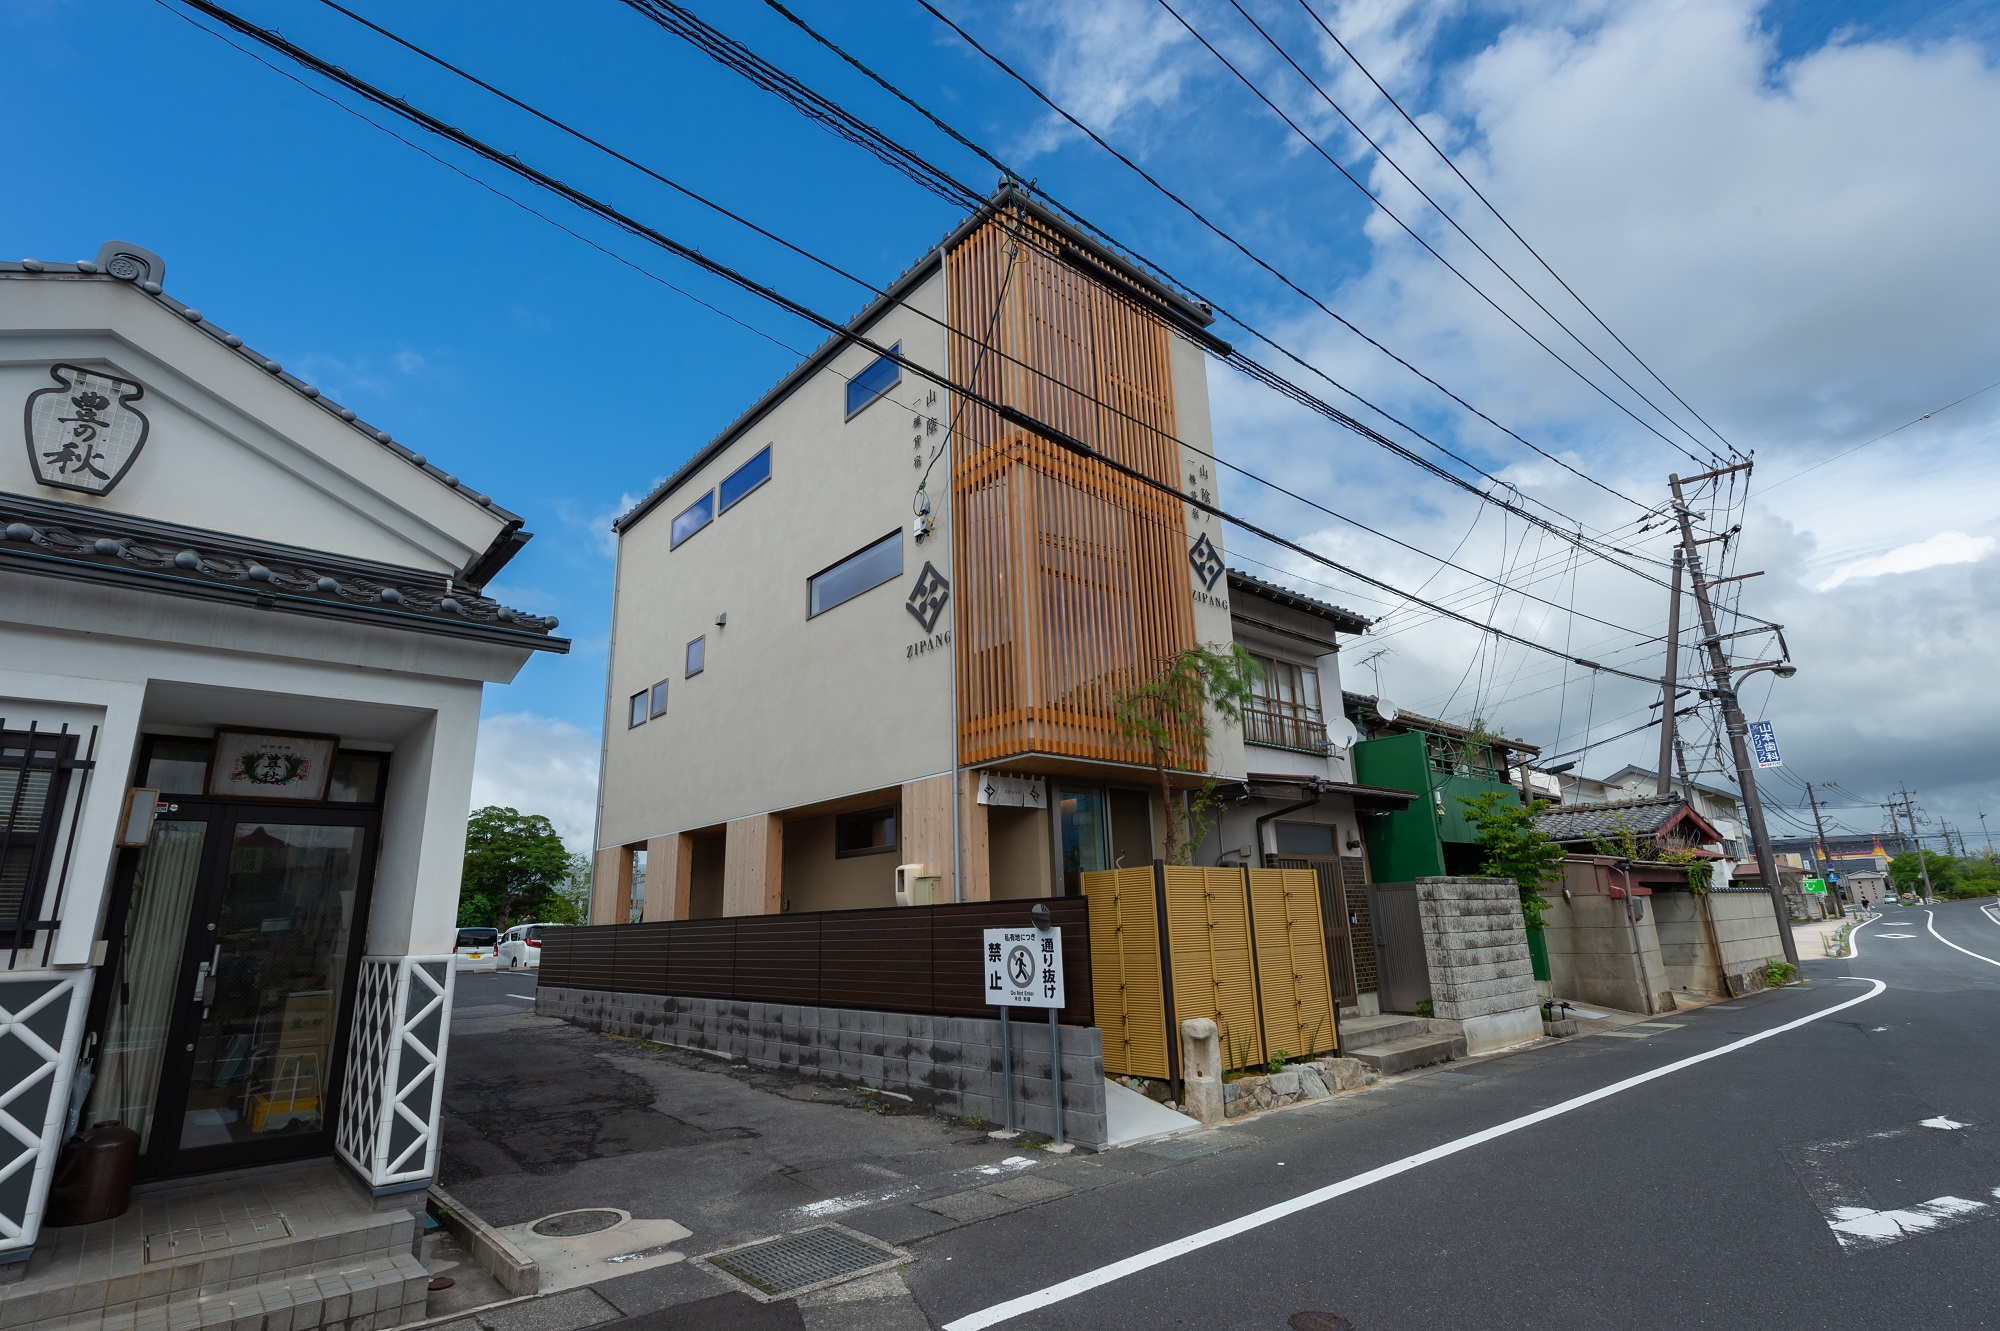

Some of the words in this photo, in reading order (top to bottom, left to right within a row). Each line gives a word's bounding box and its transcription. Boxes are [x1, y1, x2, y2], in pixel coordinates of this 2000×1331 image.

[43, 391, 111, 481] 豊の秋
[926, 388, 938, 460] 山陰ノ
[1199, 464, 1210, 523] 山陰ノ
[1192, 589, 1228, 611] ZIPANG
[906, 630, 951, 659] ZIPANG
[1753, 734, 1766, 763] クリニック
[1759, 723, 1779, 762] 山本歯科
[259, 753, 282, 782] 豊の秋
[1004, 933, 1036, 942] 私有地につき
[988, 942, 1003, 991] 禁止
[1041, 937, 1056, 999] 通り抜け
